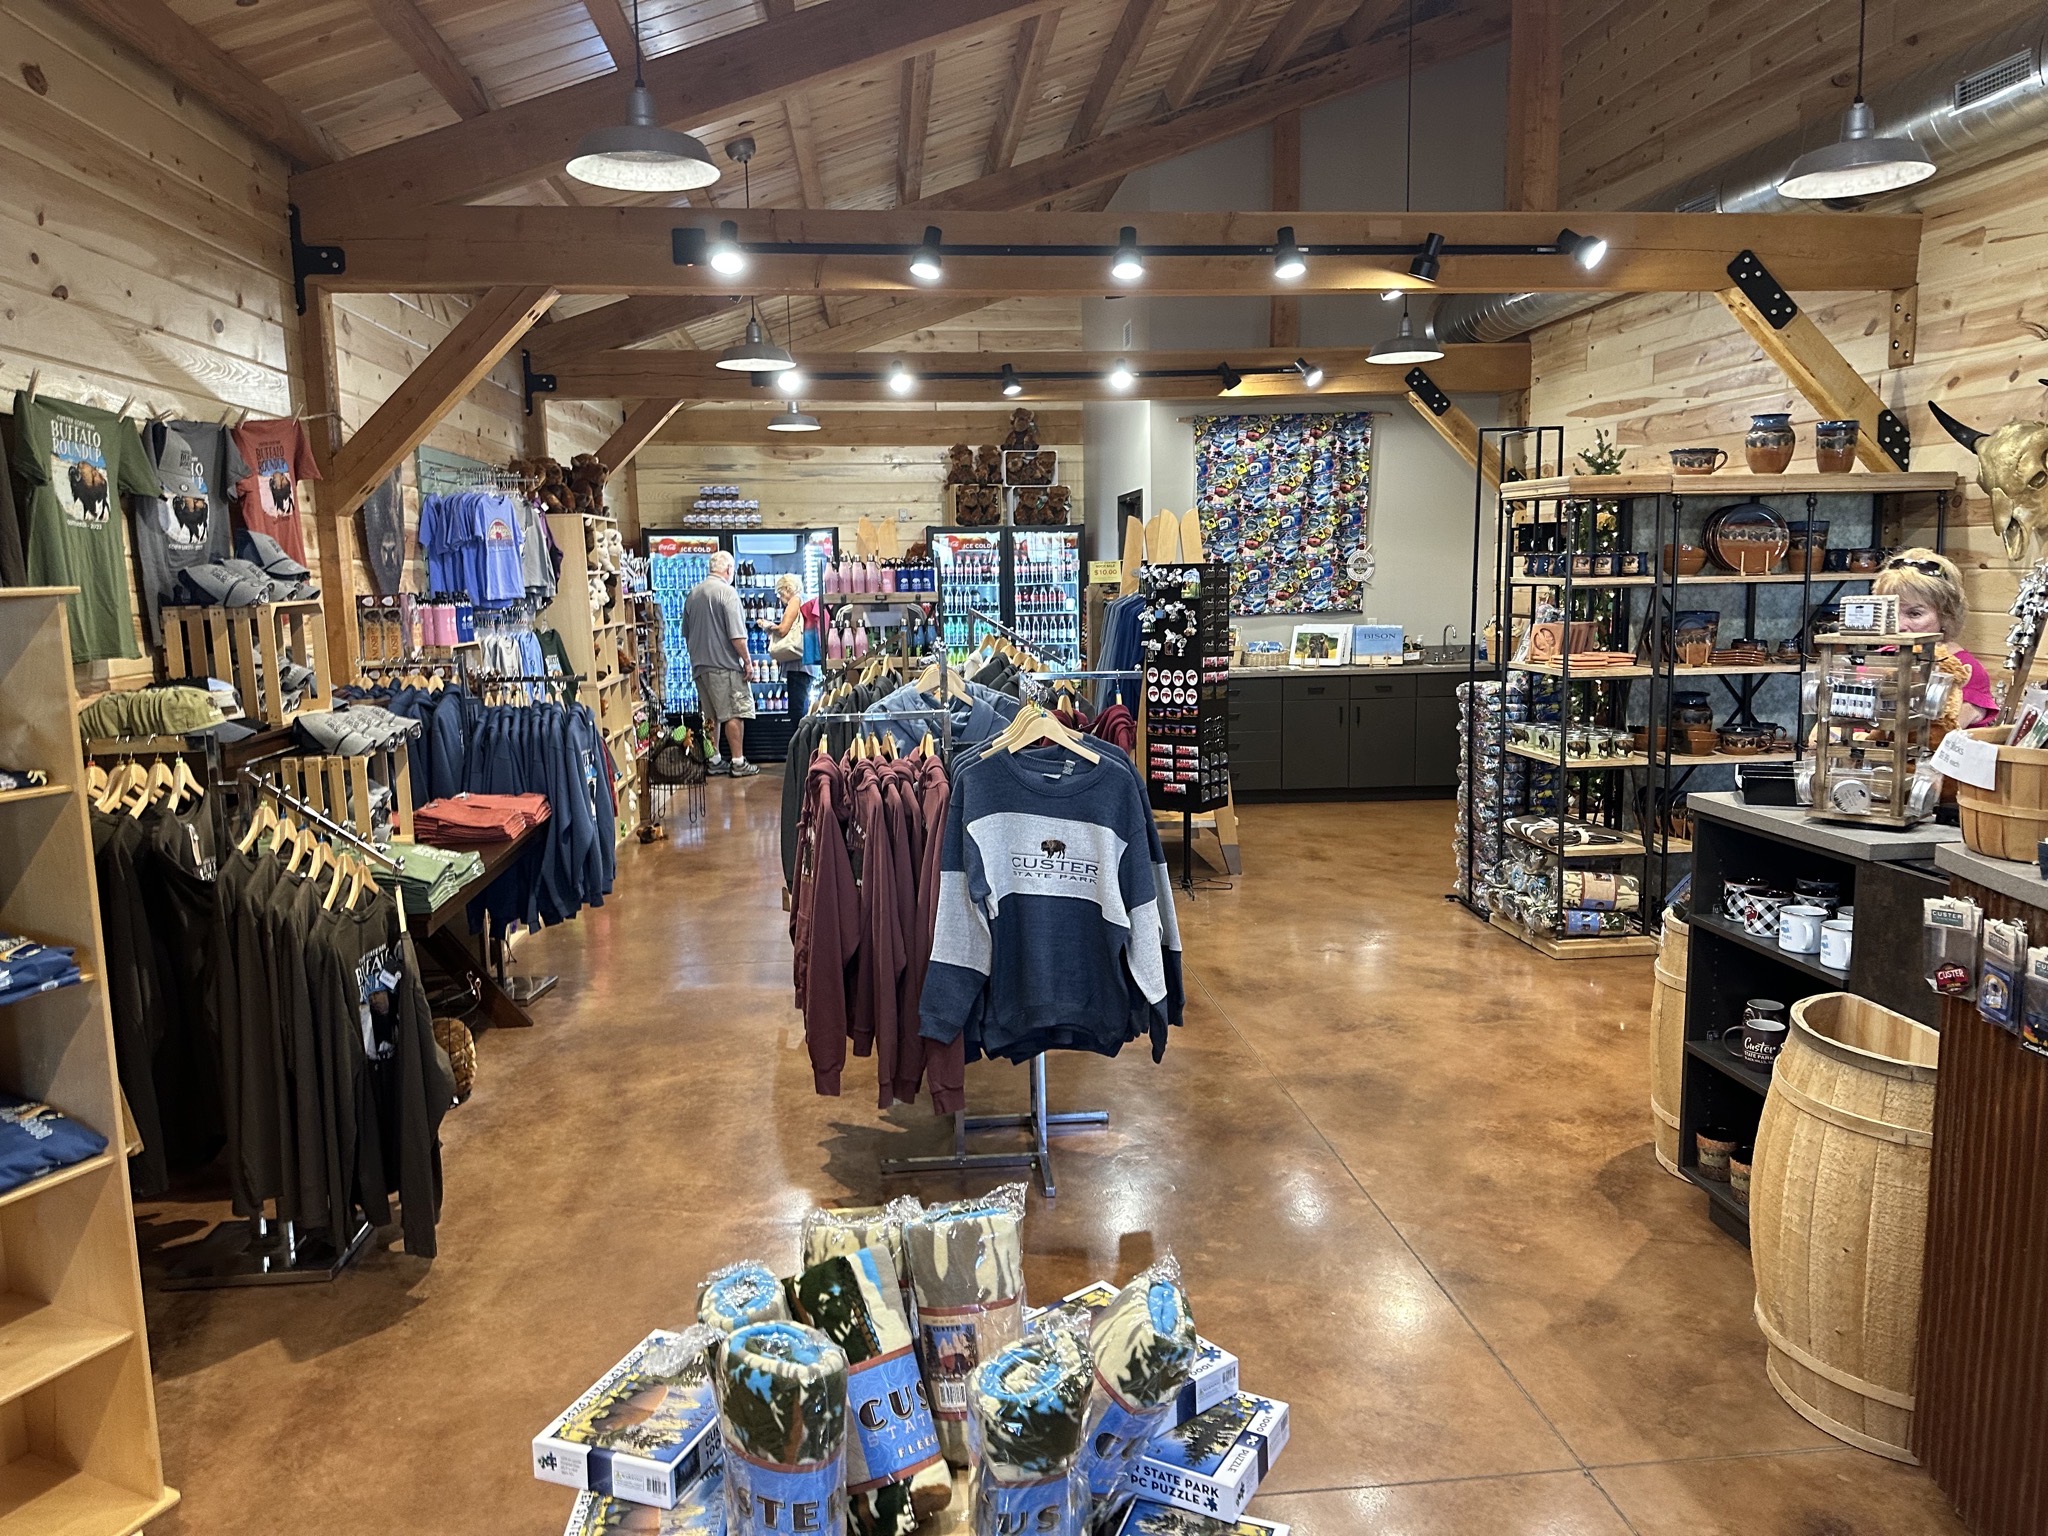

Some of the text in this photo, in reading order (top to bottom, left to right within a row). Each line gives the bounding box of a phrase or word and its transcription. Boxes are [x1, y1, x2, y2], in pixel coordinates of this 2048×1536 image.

[51, 420, 101, 448] BUFFALO
[53, 438, 101, 462] ROUNDUP
[256, 446, 284, 460] BUFFALO
[658, 543, 676, 551] Coca-Cola
[1012, 857, 1098, 876] CUSTER
[1013, 871, 1097, 885] STATE PARK
[1932, 910, 1962, 919] CUSTER
[1989, 932, 2009, 946] CUSTER
[1937, 968, 1965, 980] CUSTER
[2036, 961, 2048, 970] CUS
[1744, 1036, 1776, 1054] Custer
[1744, 1050, 1757, 1059] STATE
[1190, 1363, 1213, 1376] 1000
[859, 1380, 929, 1432] CUS
[867, 1413, 933, 1448] STAT
[1256, 1416, 1273, 1432] 1000
[706, 1438, 720, 1460] 100
[897, 1433, 938, 1459] FLEEC
[1228, 1449, 1250, 1473] PUZZLE
[1131, 1474, 1200, 1505] PC PUZZLE
[1143, 1466, 1220, 1499] STATE PARK
